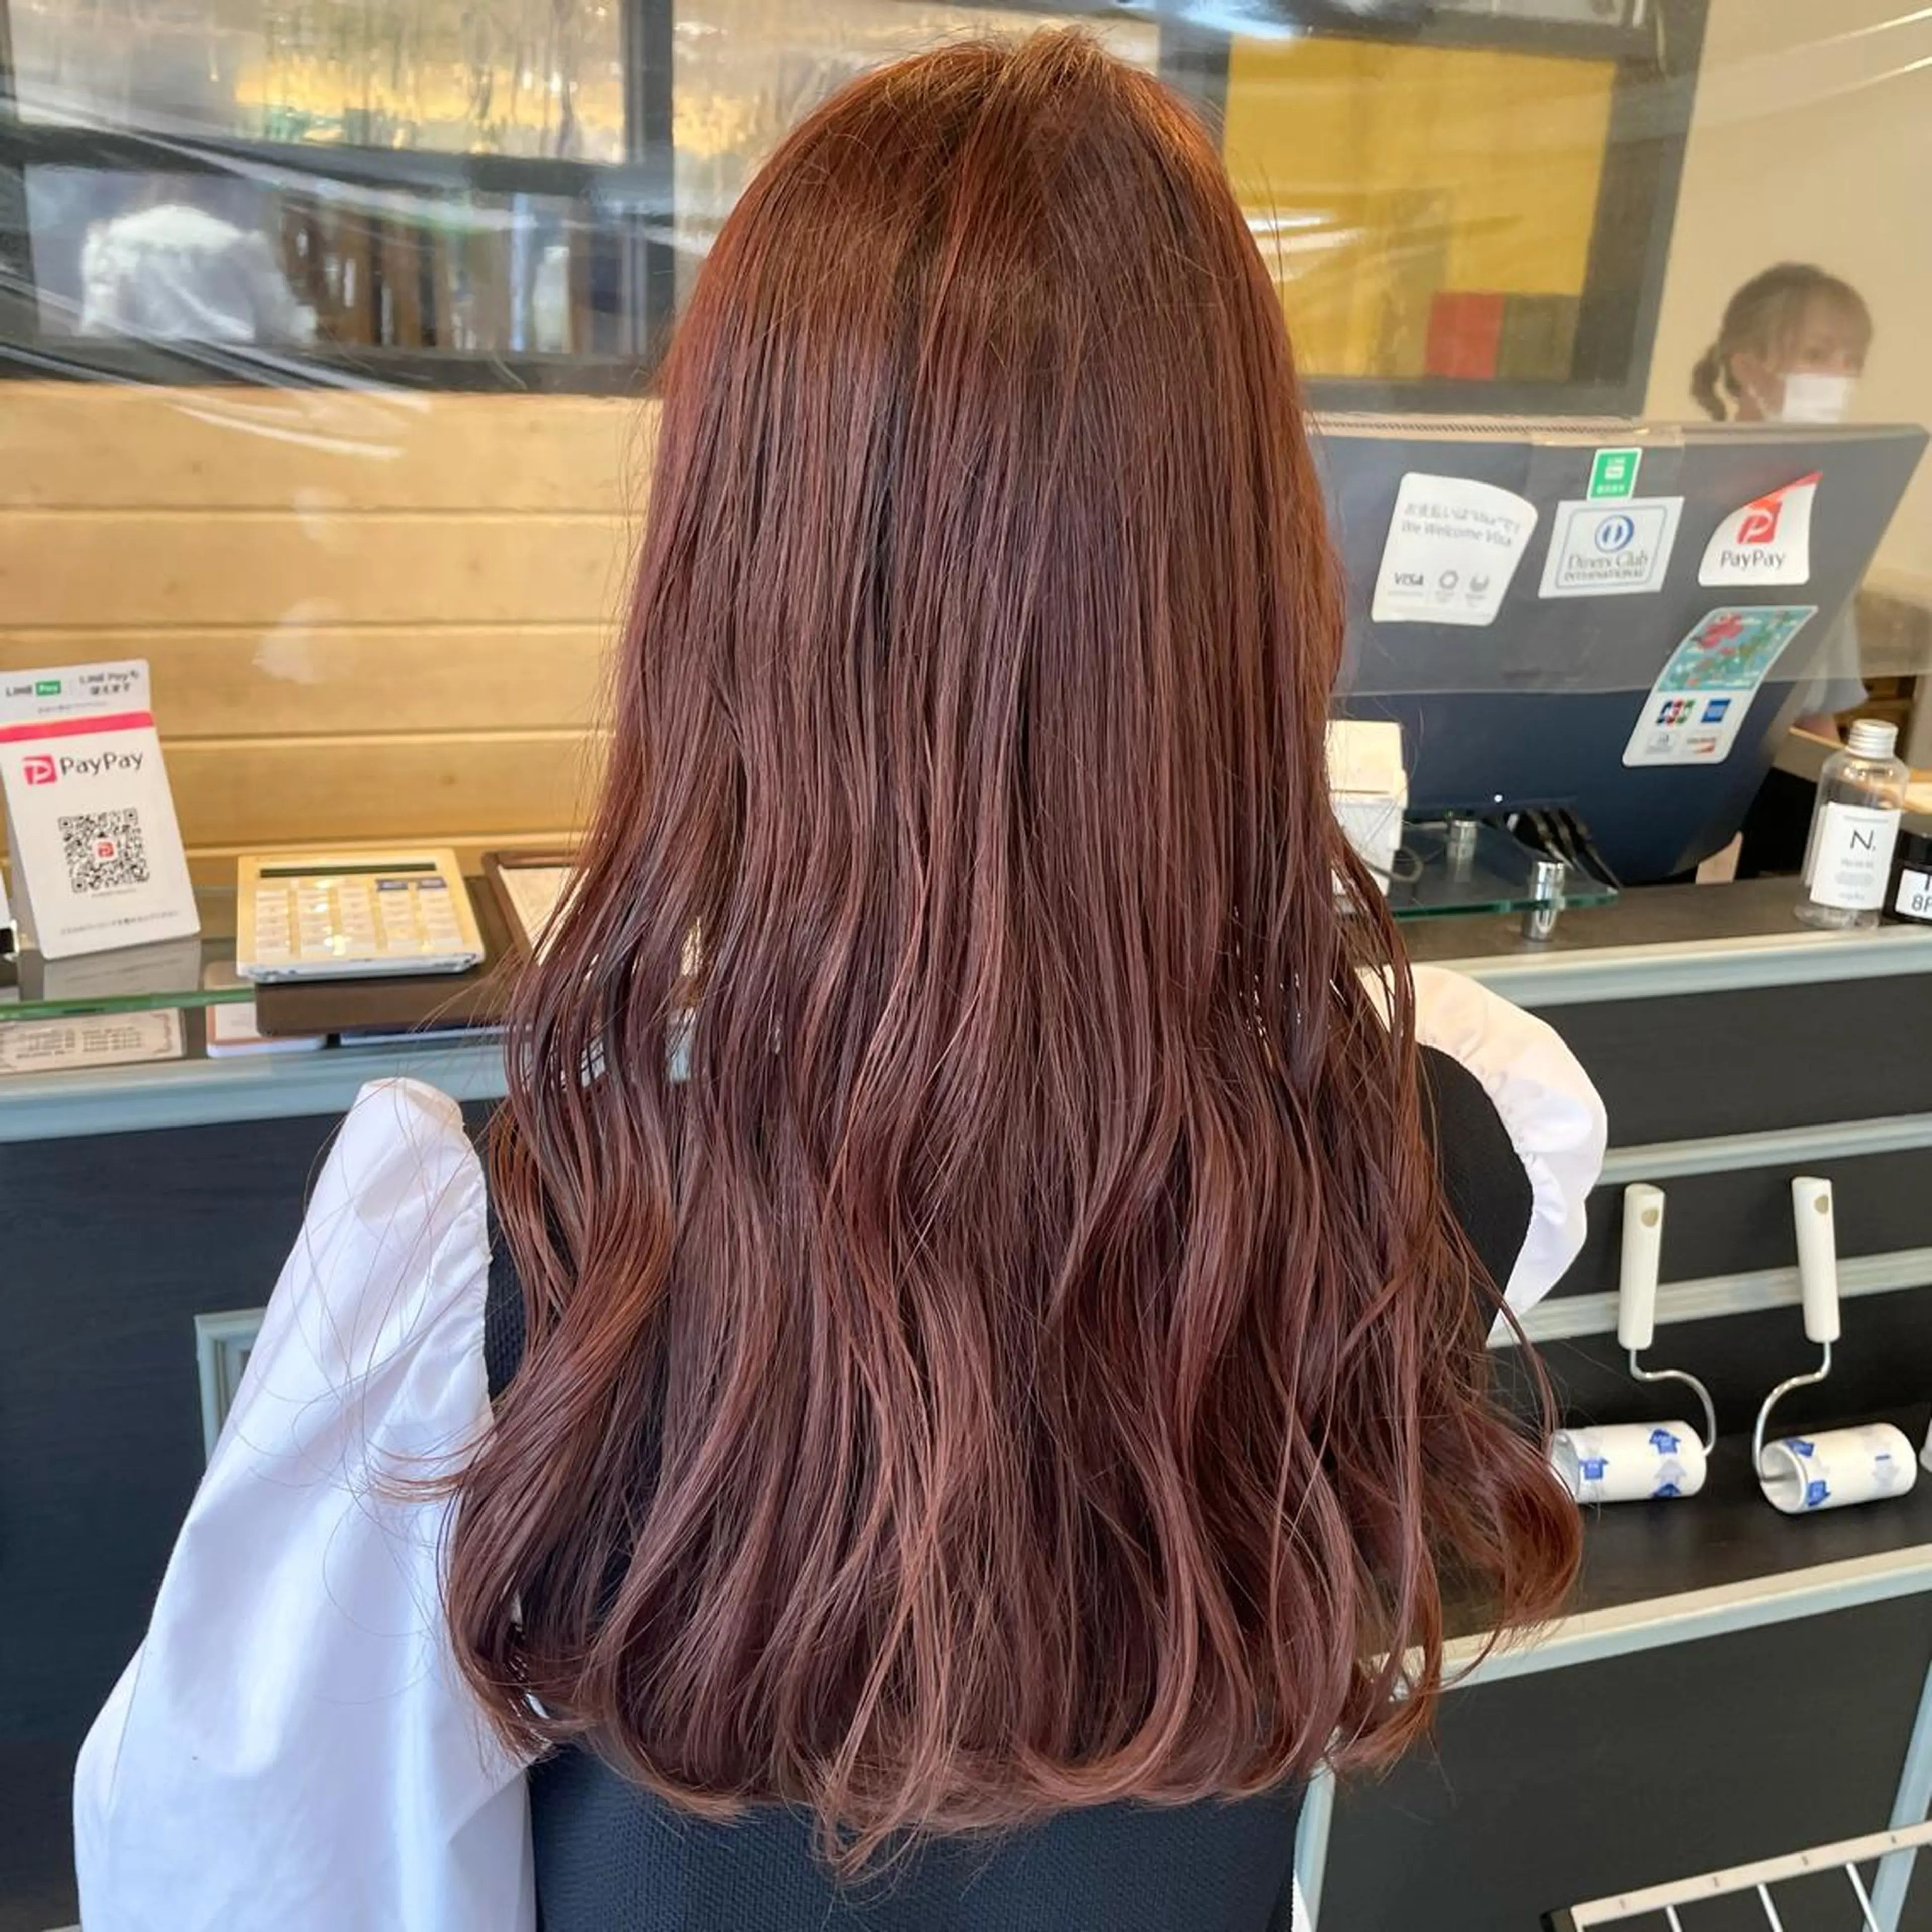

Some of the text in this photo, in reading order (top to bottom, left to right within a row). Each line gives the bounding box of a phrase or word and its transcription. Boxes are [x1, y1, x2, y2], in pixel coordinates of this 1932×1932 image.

[1569, 550, 1648, 569] Diners Club
[1720, 549, 1785, 571] PayPay
[1394, 572, 1424, 586] VISA
[60, 752, 143, 776] PayPay
[1849, 829, 1876, 851] N.
